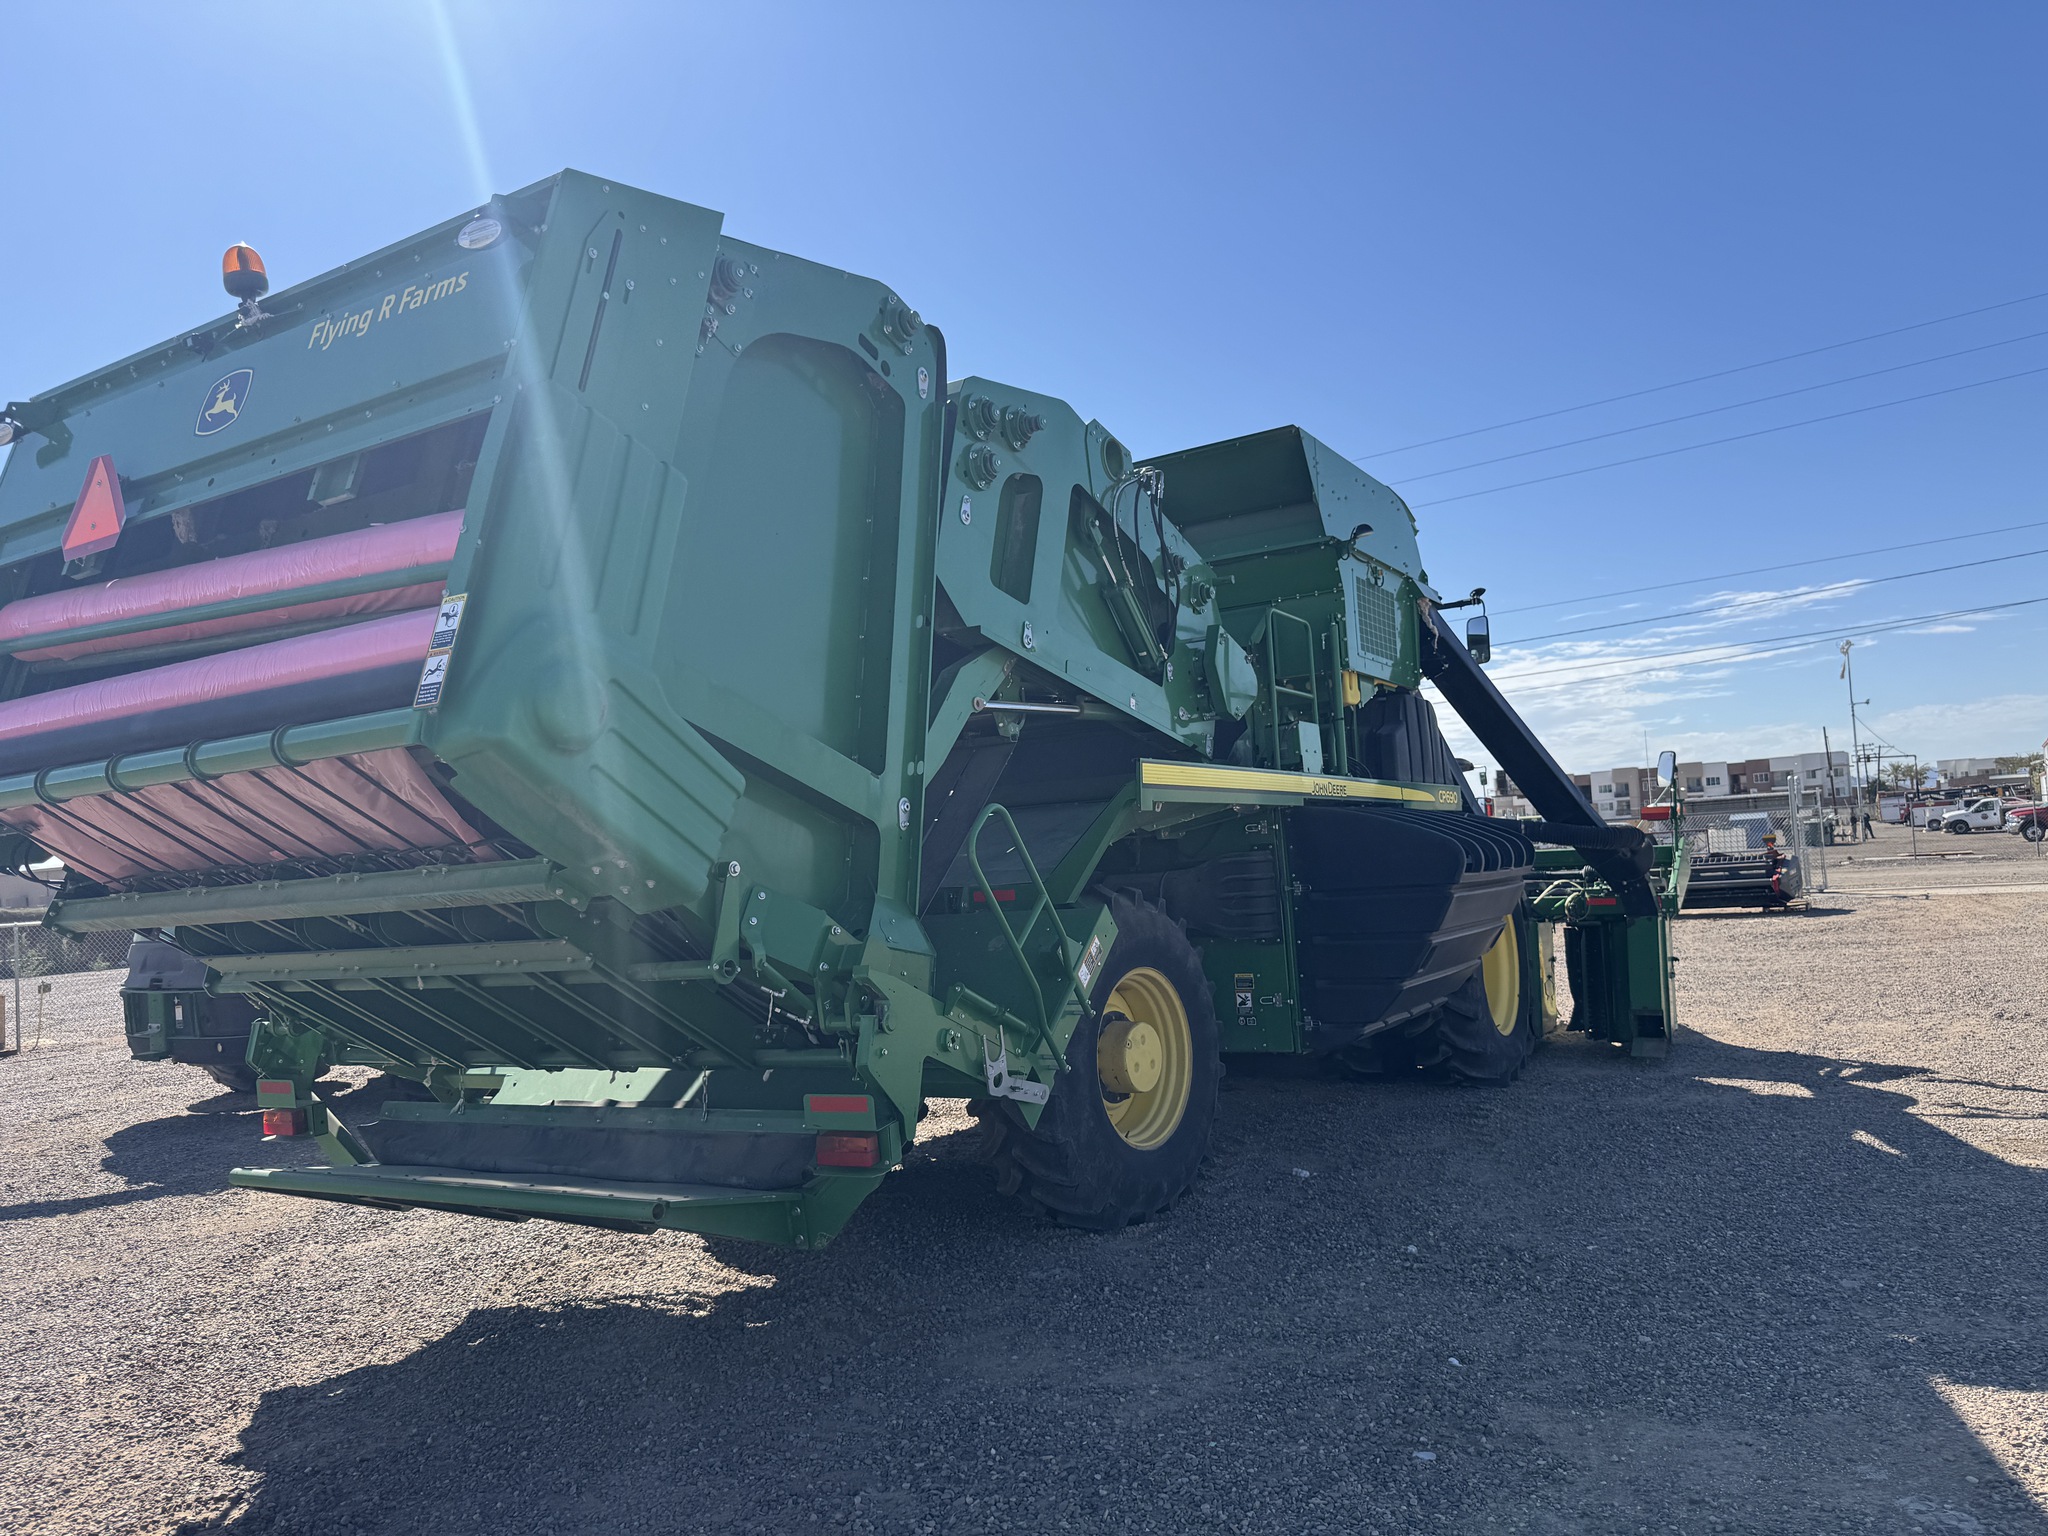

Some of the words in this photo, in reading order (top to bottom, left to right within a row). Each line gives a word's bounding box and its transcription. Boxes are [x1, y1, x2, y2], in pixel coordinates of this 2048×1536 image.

[308, 308, 374, 350] Flying
[377, 293, 396, 322] R
[398, 271, 469, 314] Farms
[1311, 781, 1328, 795] JOHN
[1328, 782, 1347, 796] DEERE
[1439, 790, 1457, 804] CP690
